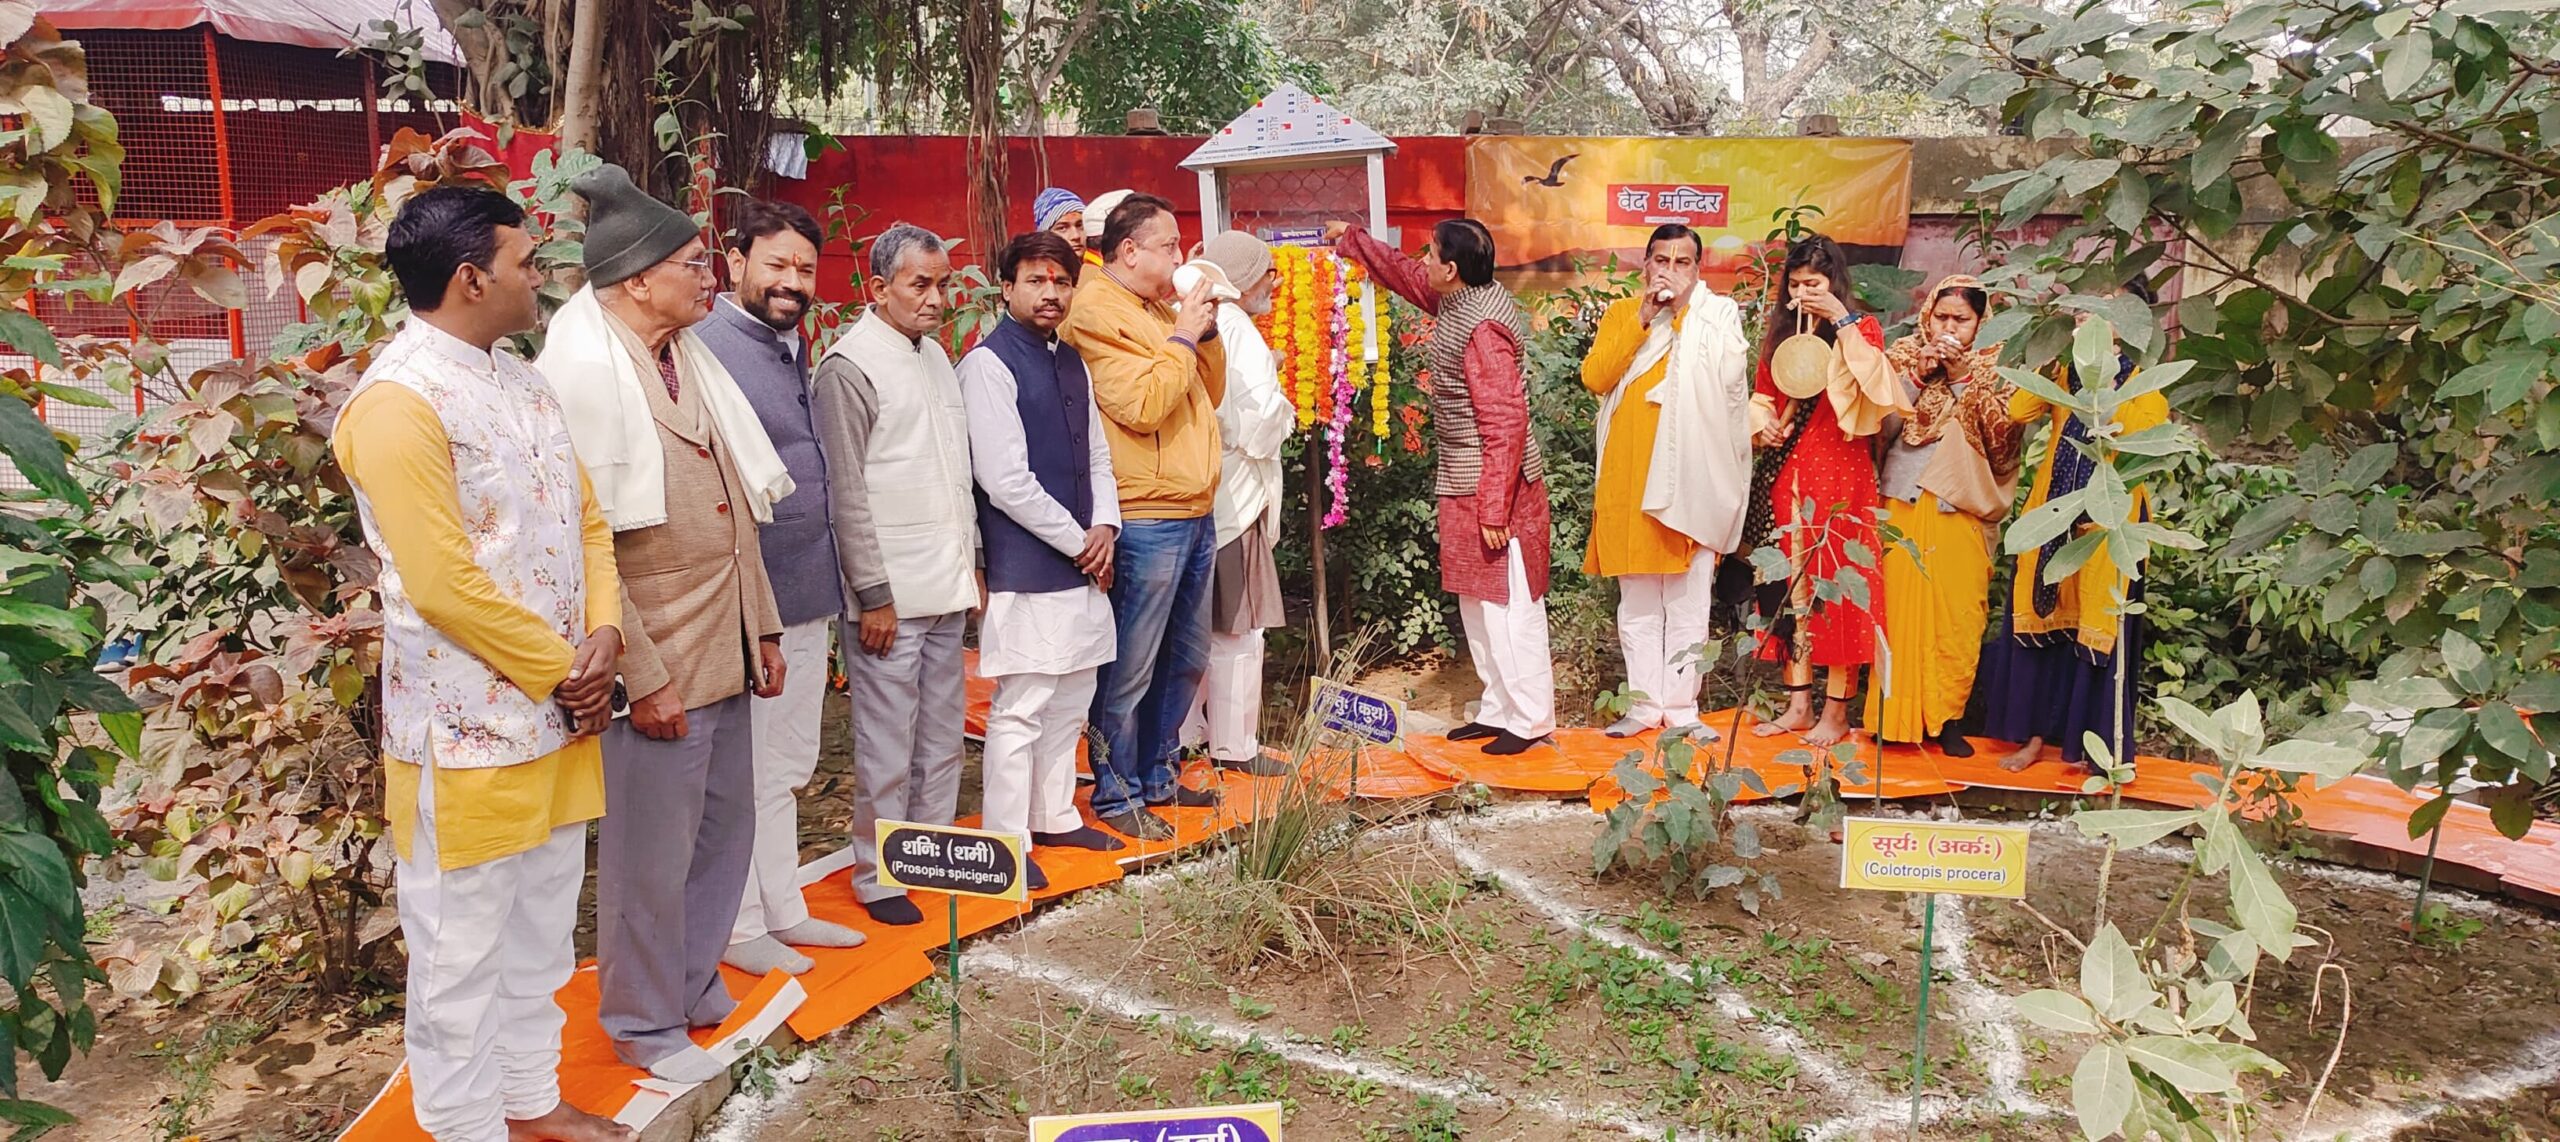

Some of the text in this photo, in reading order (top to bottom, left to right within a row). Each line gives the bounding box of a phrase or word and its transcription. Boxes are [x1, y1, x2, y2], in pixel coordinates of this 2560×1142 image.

[1618, 186, 1723, 213] वेद मन्दिर
[902, 835, 996, 870] शनिः (शमी)
[1871, 832, 2004, 861] सूर्यः (अर्कः)
[891, 860, 1009, 887] (Prosopis spicigeral)
[1864, 861, 2007, 885] (Colotropis procera)
